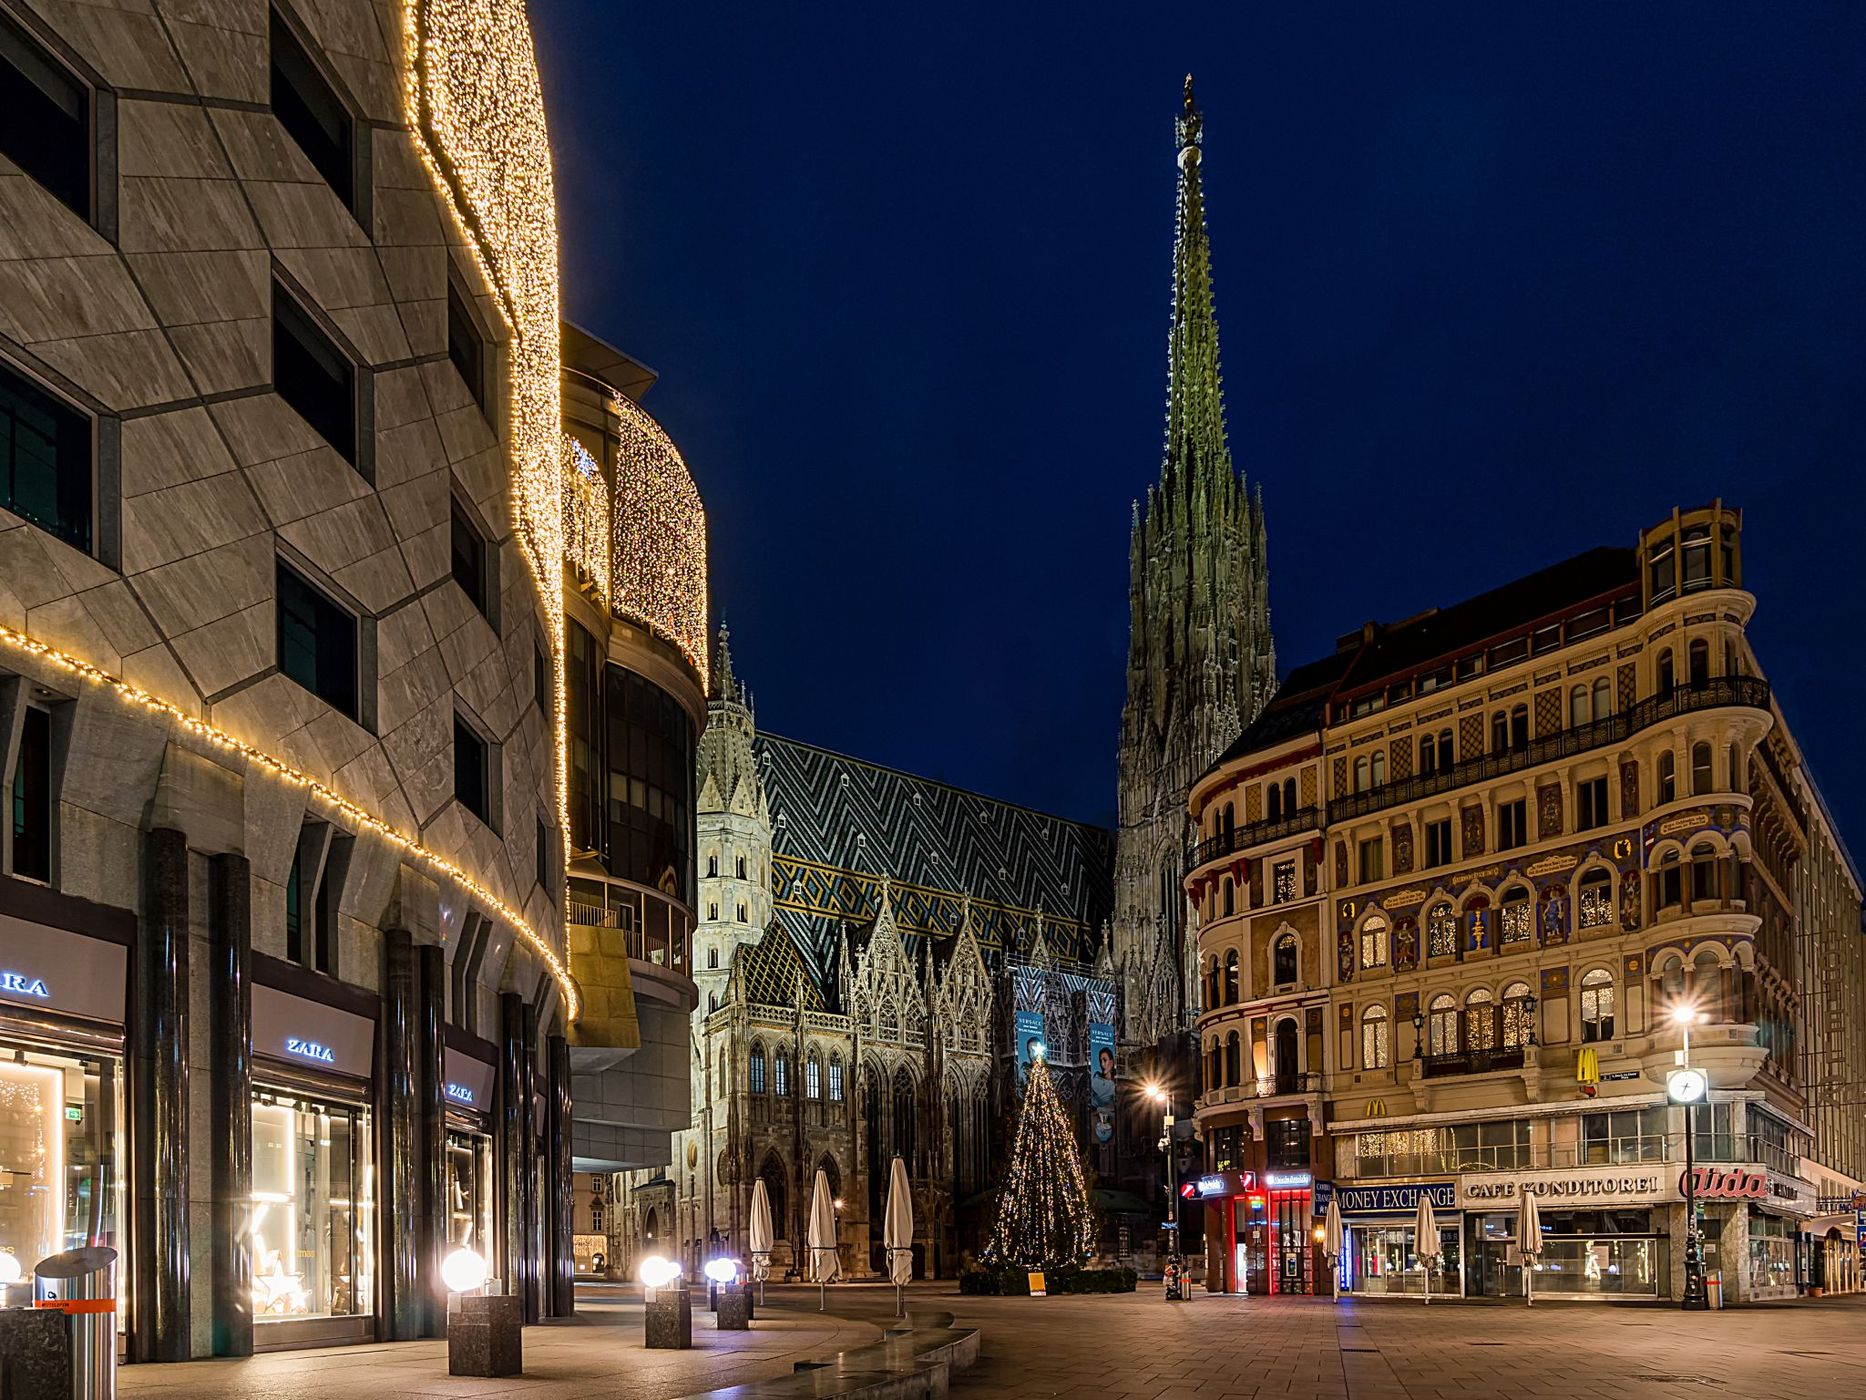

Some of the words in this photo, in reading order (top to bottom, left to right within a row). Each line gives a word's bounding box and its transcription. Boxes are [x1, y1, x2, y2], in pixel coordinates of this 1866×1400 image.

[0, 972, 50, 997] RA
[287, 1039, 335, 1062] ZARA
[448, 1083, 474, 1102] ZARA
[1520, 1176, 1658, 1198] KONDITOREI
[1680, 1168, 1768, 1198] Aida
[1336, 1190, 1380, 1209] MONEY
[1383, 1187, 1455, 1208] EXCHNGE
